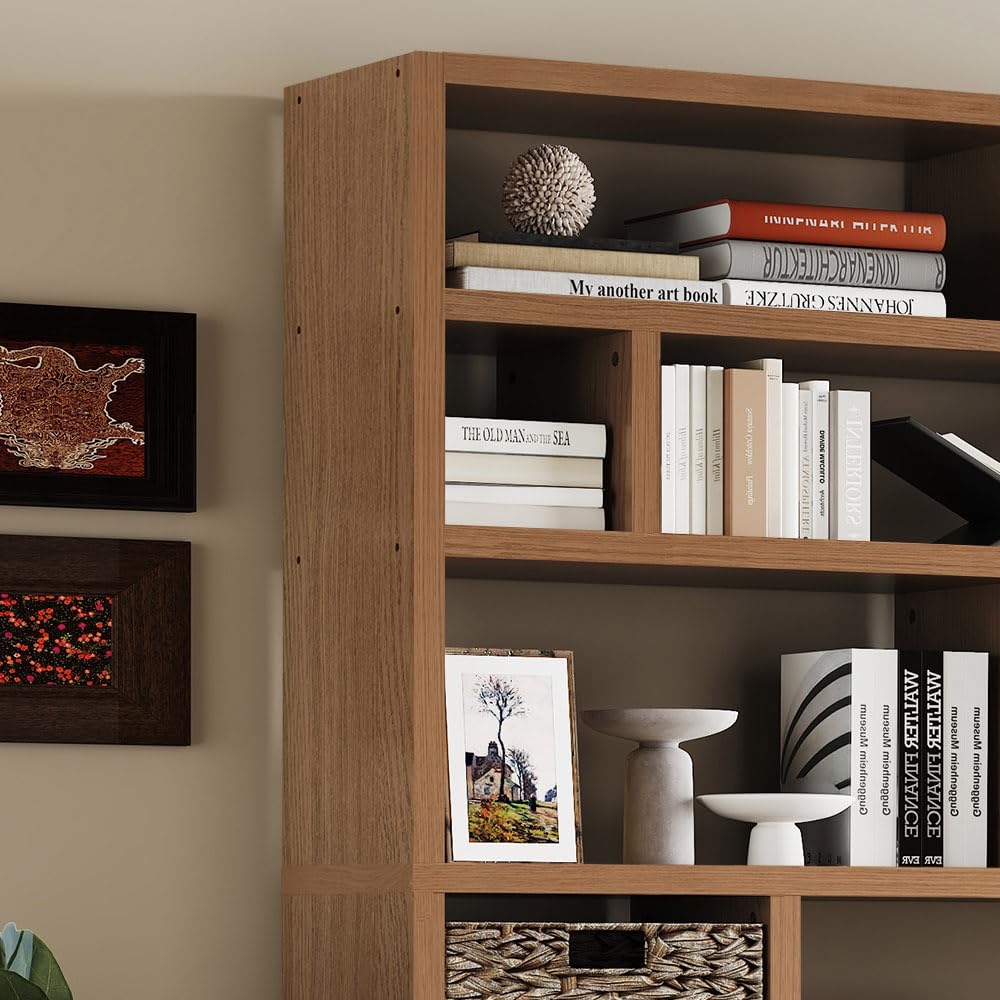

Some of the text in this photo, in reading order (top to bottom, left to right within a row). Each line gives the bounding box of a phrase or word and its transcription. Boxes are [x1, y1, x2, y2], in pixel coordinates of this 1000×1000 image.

[762, 246, 901, 287] INNENARCHITEKTUR
[569, 279, 719, 303] My another art book
[827, 295, 914, 314] JOHANNES
[462, 426, 571, 446] THE OLD MAN AND THE SEA
